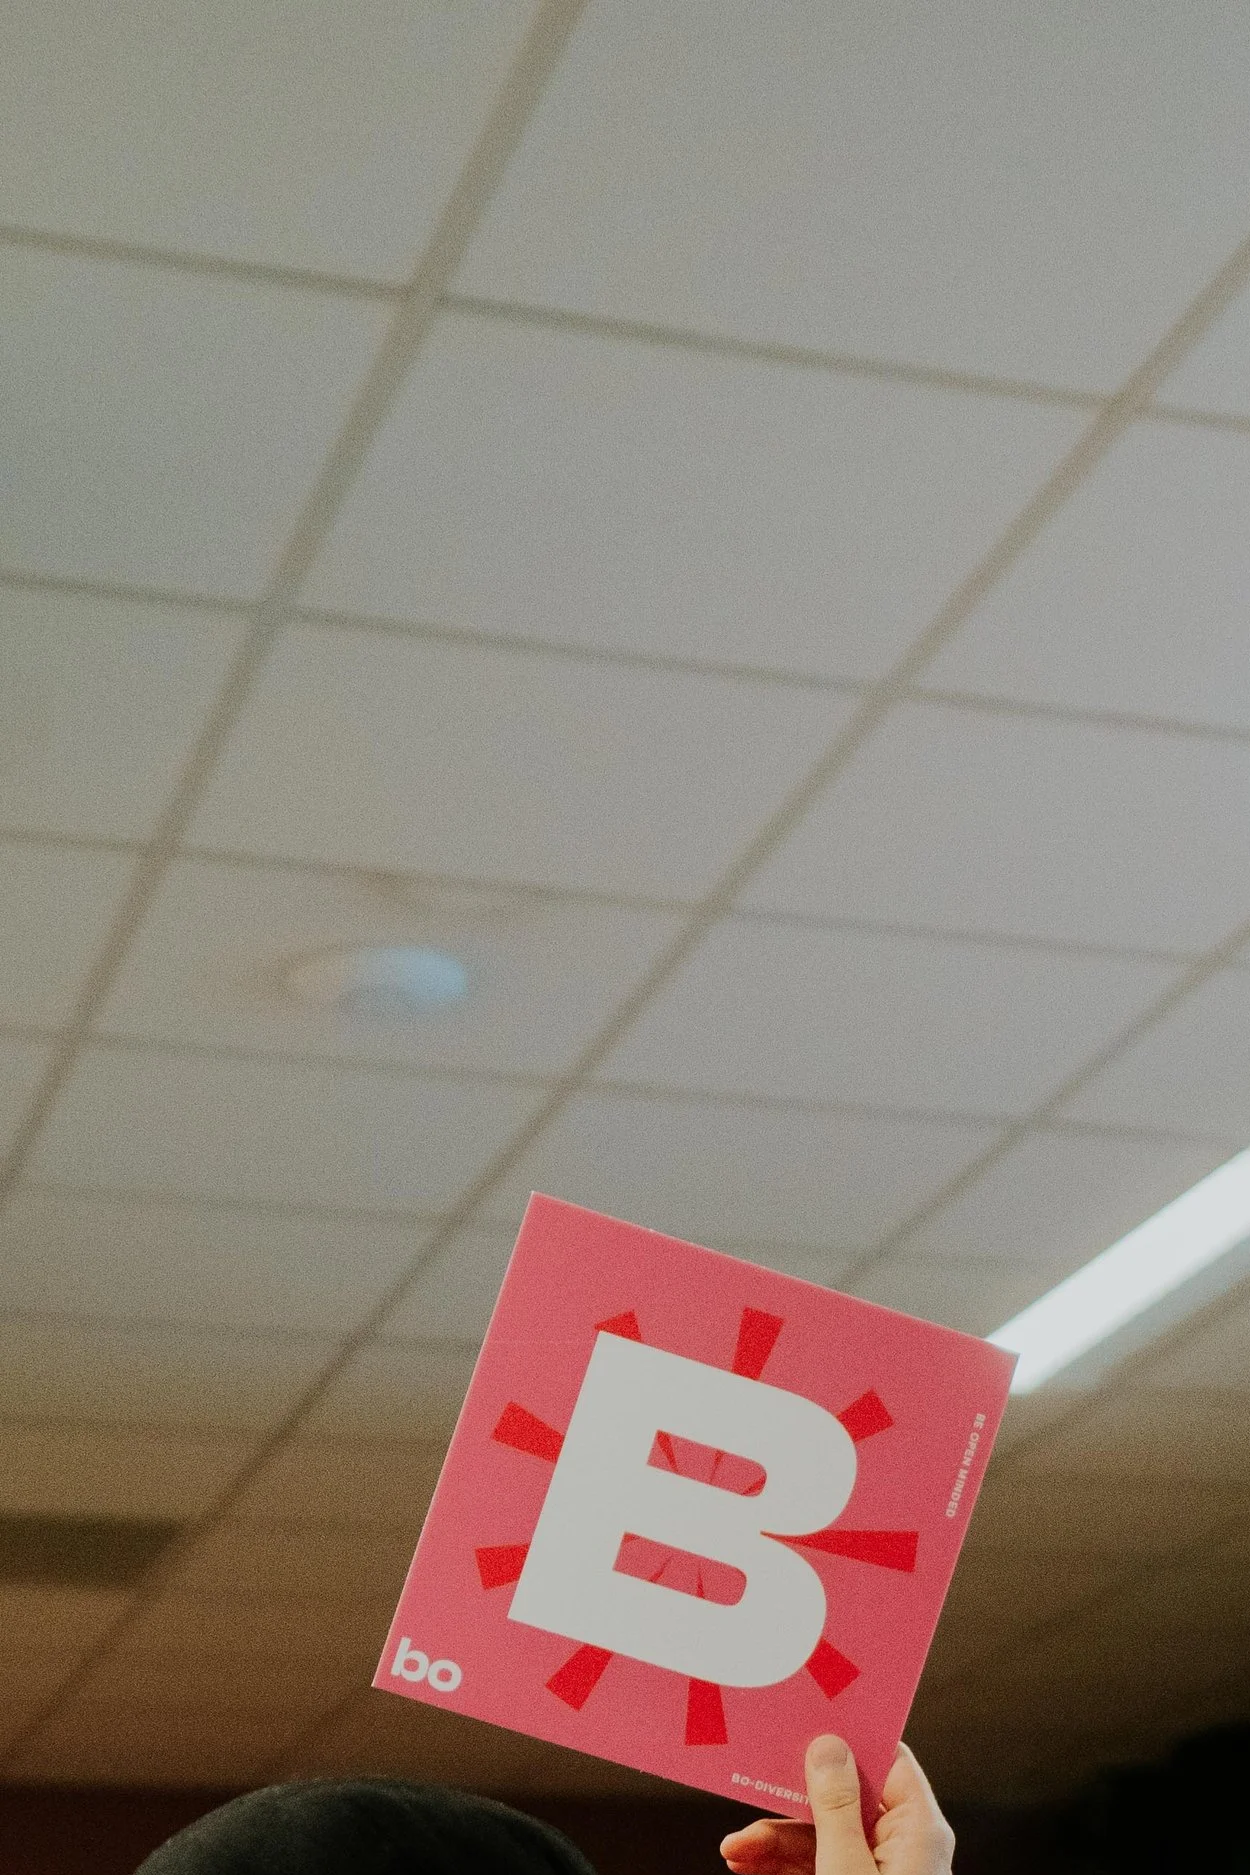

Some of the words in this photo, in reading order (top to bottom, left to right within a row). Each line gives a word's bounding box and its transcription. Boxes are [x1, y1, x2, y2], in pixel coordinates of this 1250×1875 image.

[973, 1413, 986, 1430] BE
[963, 1432, 979, 1466] OPEN
[508, 1331, 857, 1688] B
[945, 1469, 968, 1518] MINDED
[391, 1636, 462, 1692] bo
